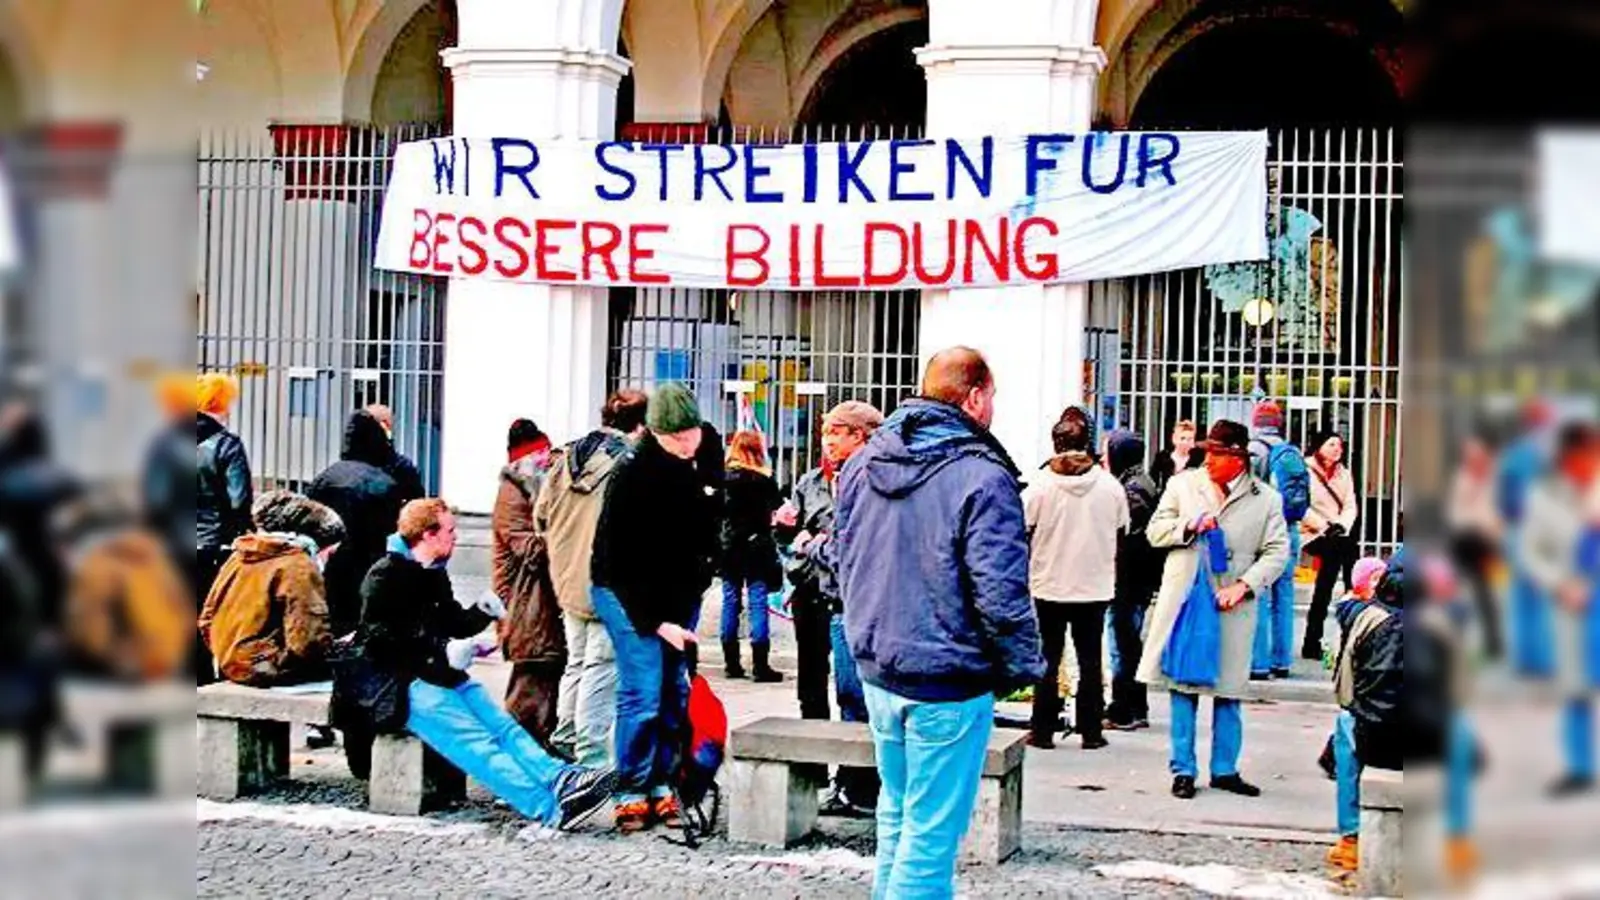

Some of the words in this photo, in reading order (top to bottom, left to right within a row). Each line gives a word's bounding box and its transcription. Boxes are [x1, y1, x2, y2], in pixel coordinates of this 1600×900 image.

[431, 137, 540, 199] WIR
[594, 136, 993, 203] STREIKEN
[409, 208, 672, 284] BESSERE
[725, 216, 1060, 287] BILDUNG
